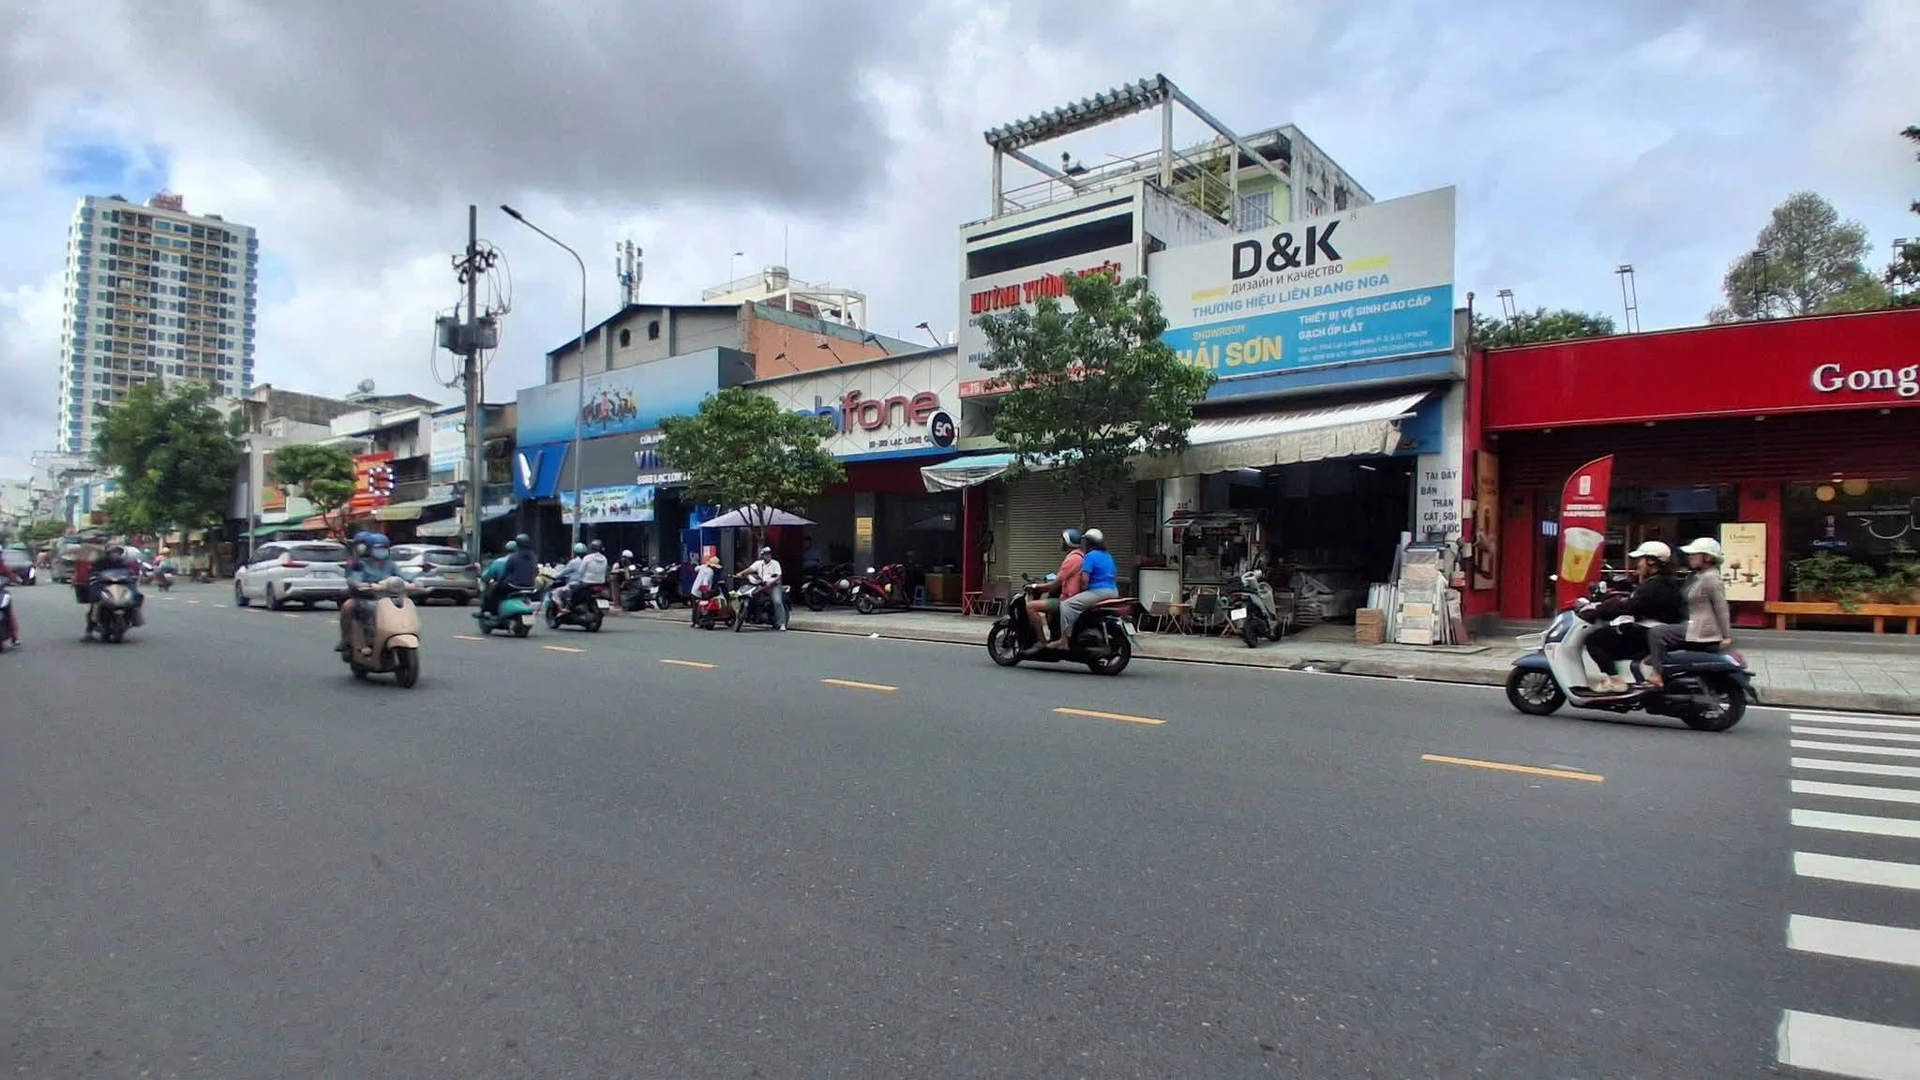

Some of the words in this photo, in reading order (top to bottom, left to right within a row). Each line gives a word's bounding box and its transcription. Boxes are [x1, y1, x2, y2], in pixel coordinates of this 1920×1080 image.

[1232, 220, 1342, 280] D&K
[1231, 276, 1274, 295] дизайн
[1276, 276, 1284, 285] и
[1287, 264, 1344, 284] качество
[1246, 293, 1276, 310] HIỆU
[1279, 286, 1310, 304] LIÊN
[1313, 280, 1354, 296] BANG
[1357, 274, 1389, 289] NGA
[1356, 303, 1381, 316] SINH
[1382, 299, 1405, 312] CAO
[1226, 335, 1282, 367] SƠN
[1812, 362, 1919, 397] Gong
[795, 389, 940, 435] bifone
